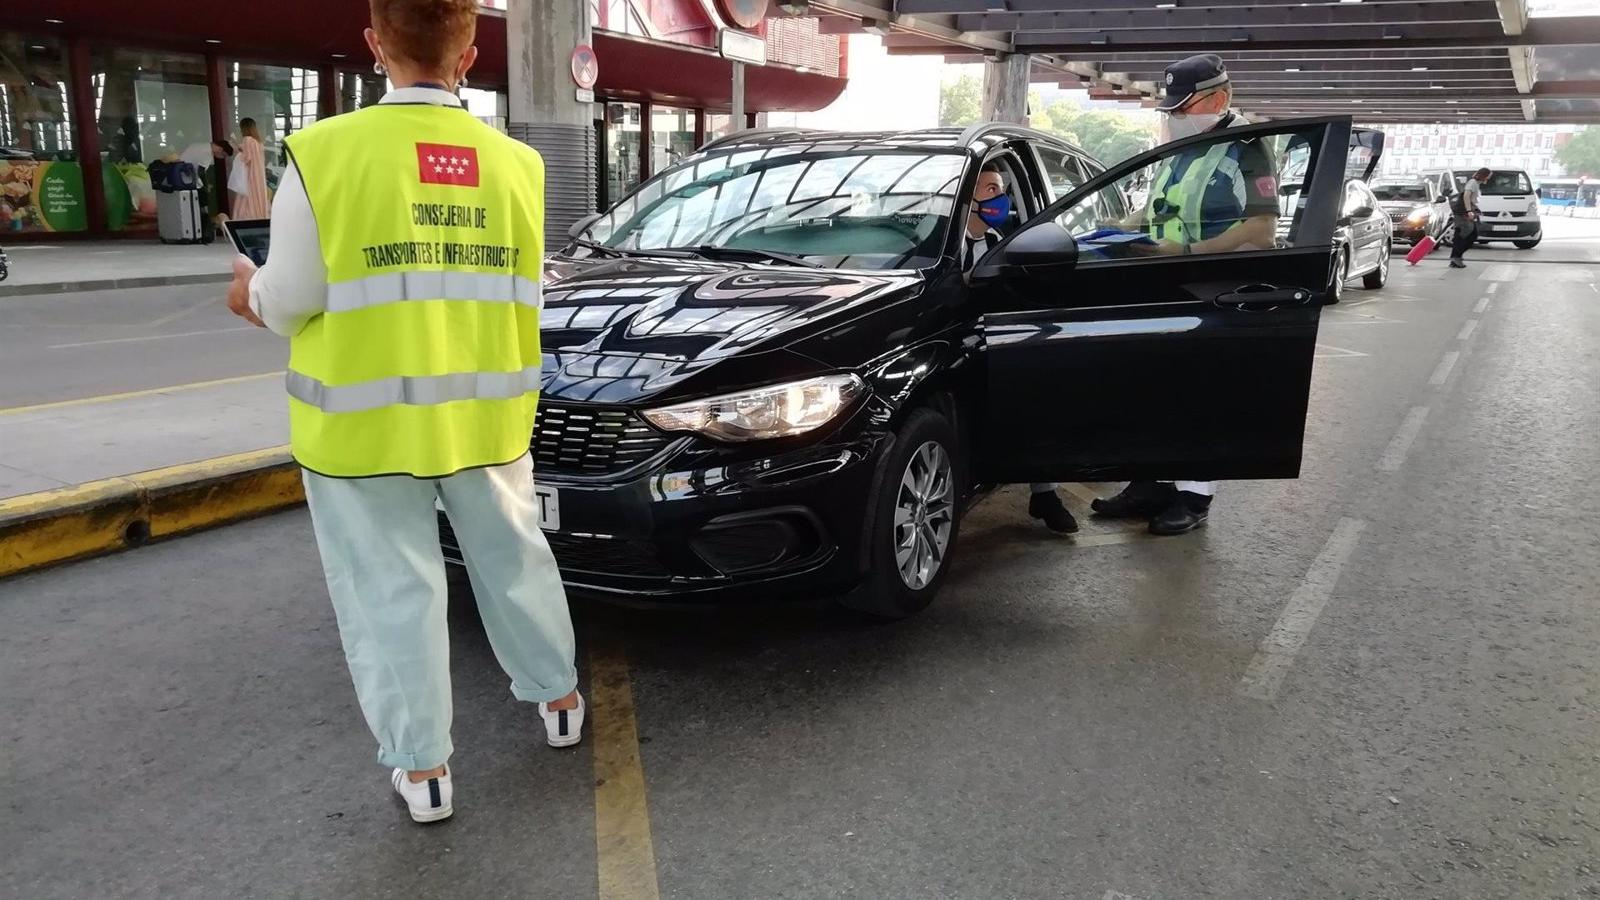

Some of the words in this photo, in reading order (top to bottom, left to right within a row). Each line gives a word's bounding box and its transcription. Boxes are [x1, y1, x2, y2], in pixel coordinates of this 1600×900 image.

[412, 203, 471, 227] CONSEJERIA
[474, 207, 486, 229] DE
[362, 242, 432, 268] TRANSPORTES
[435, 242, 440, 264] E
